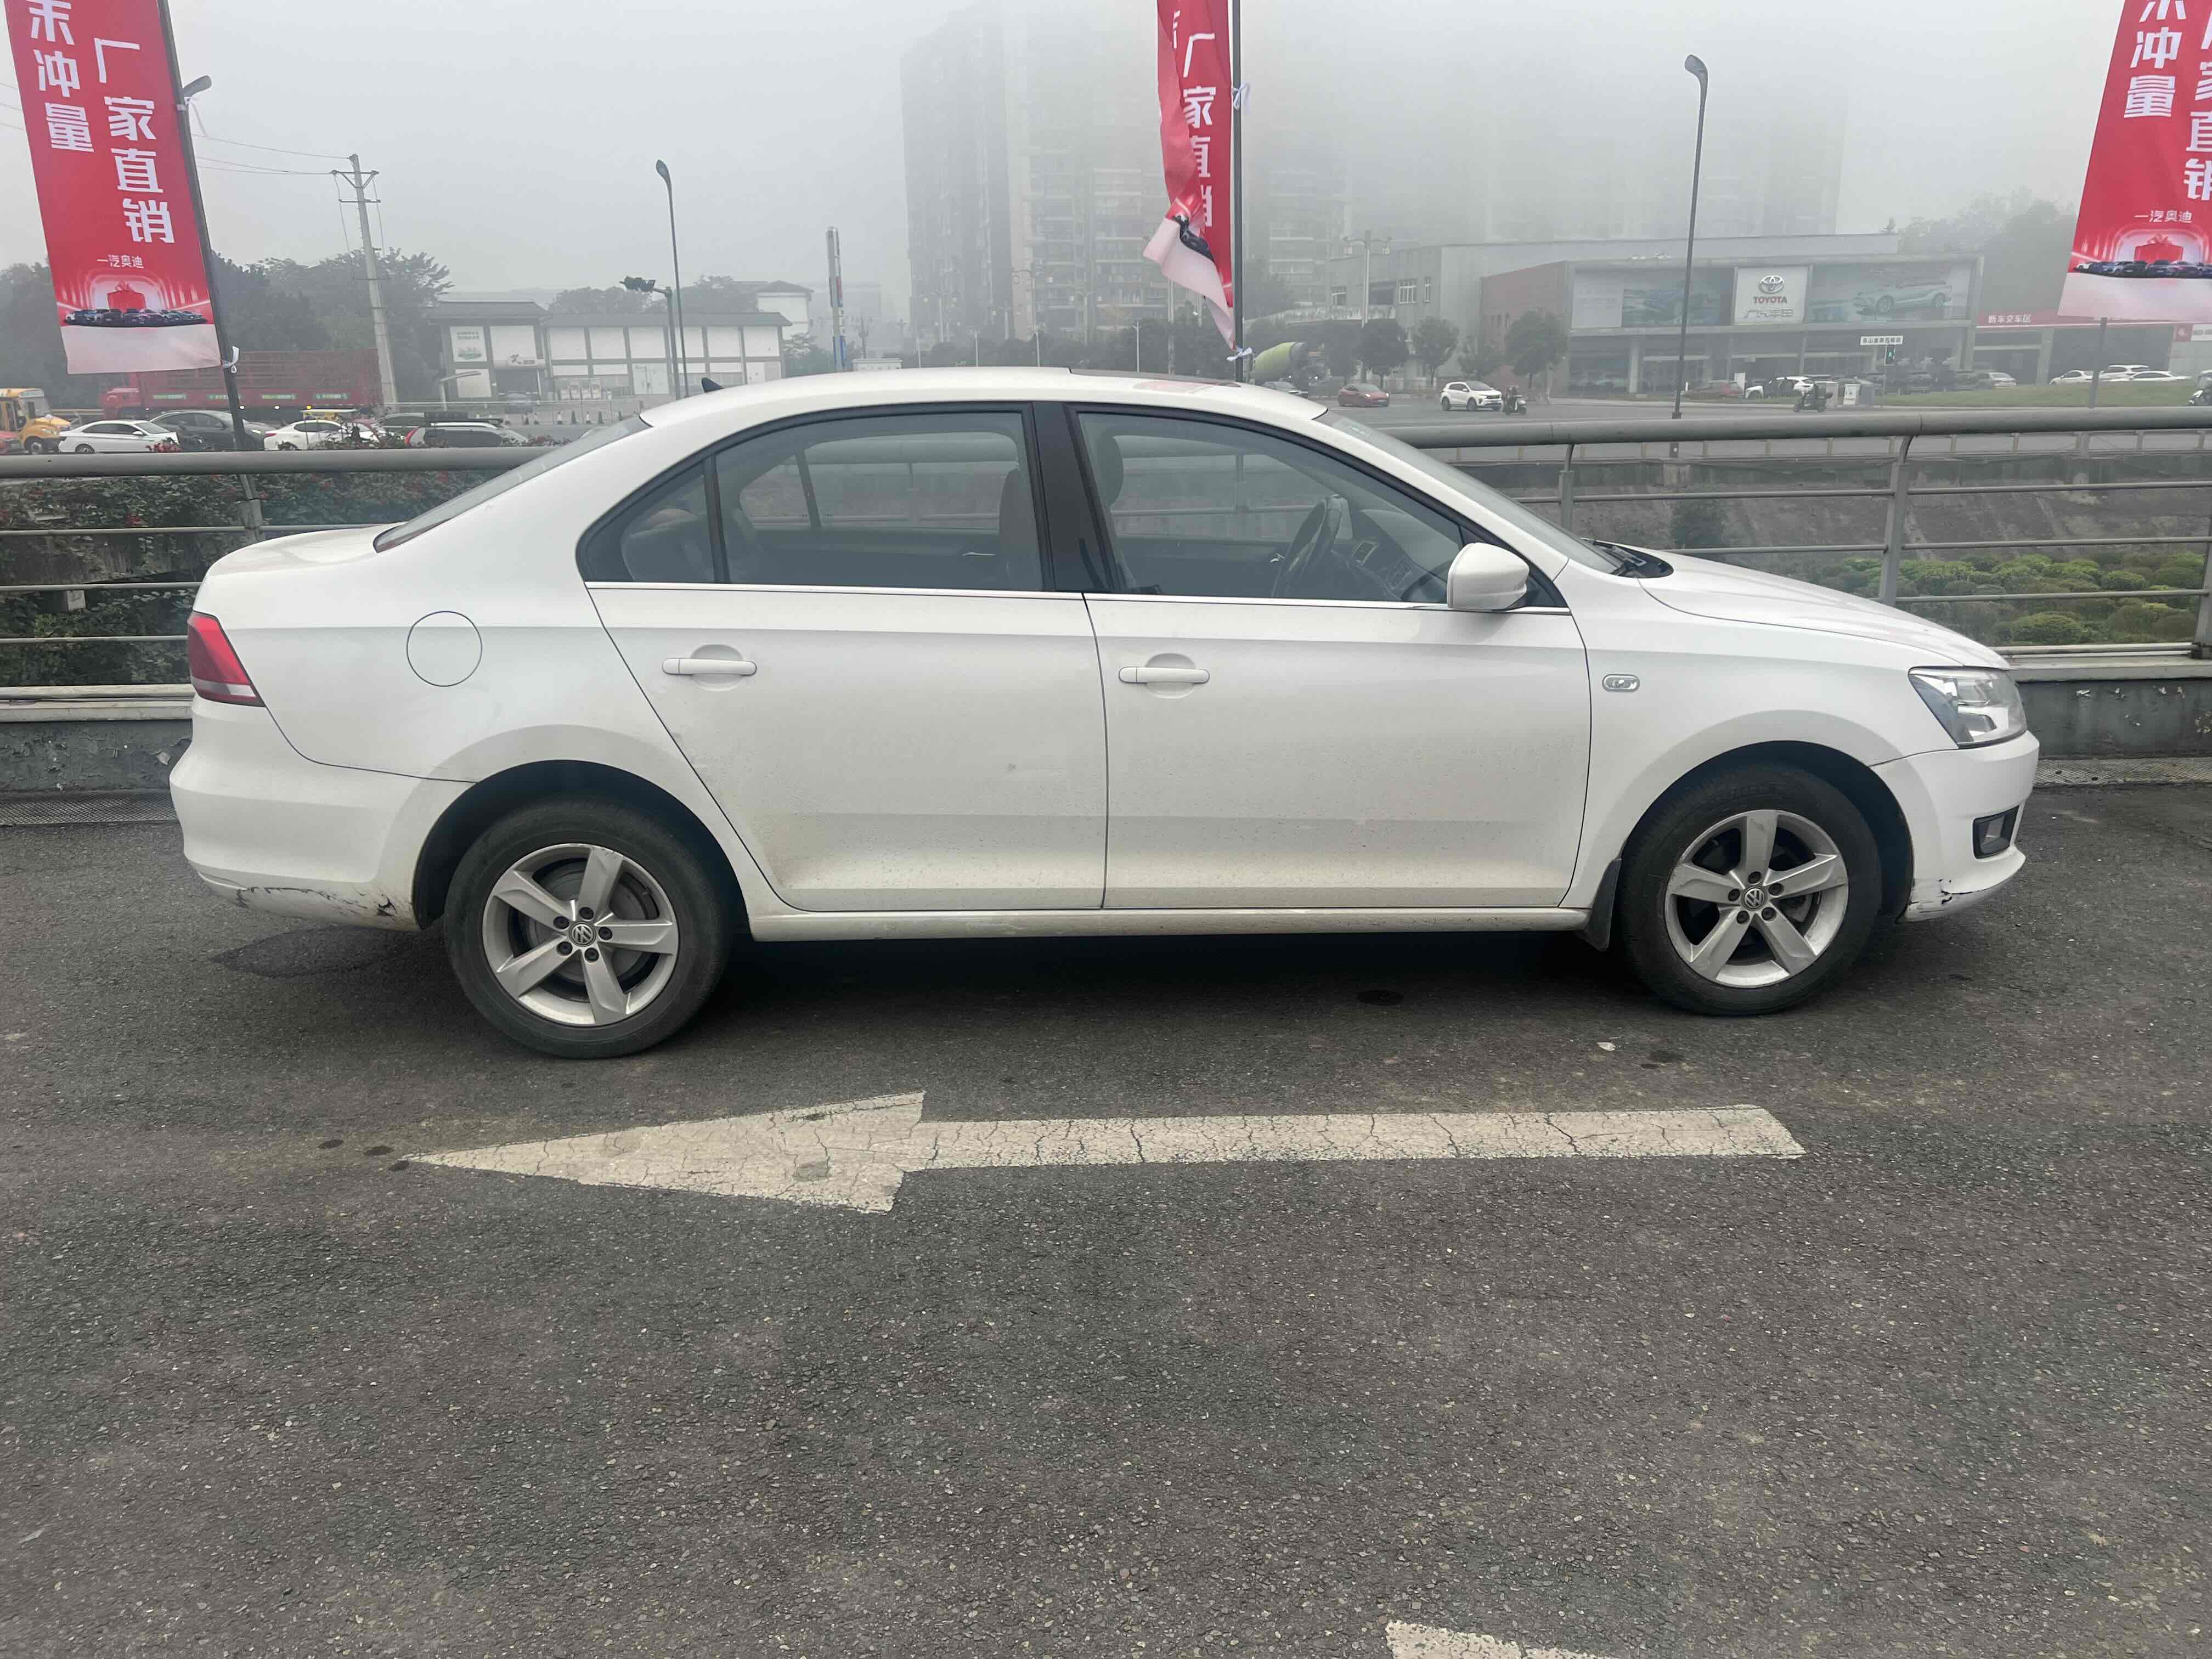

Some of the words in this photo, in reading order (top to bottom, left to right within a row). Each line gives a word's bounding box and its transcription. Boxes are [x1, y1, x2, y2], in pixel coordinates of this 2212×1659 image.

[94, 37, 175, 243] 厂家直销
[2134, 210, 2193, 223] 一汽奥迪
[97, 254, 144, 269] 一汽奥迪
[1743, 308, 1794, 318] 广汽丰田
